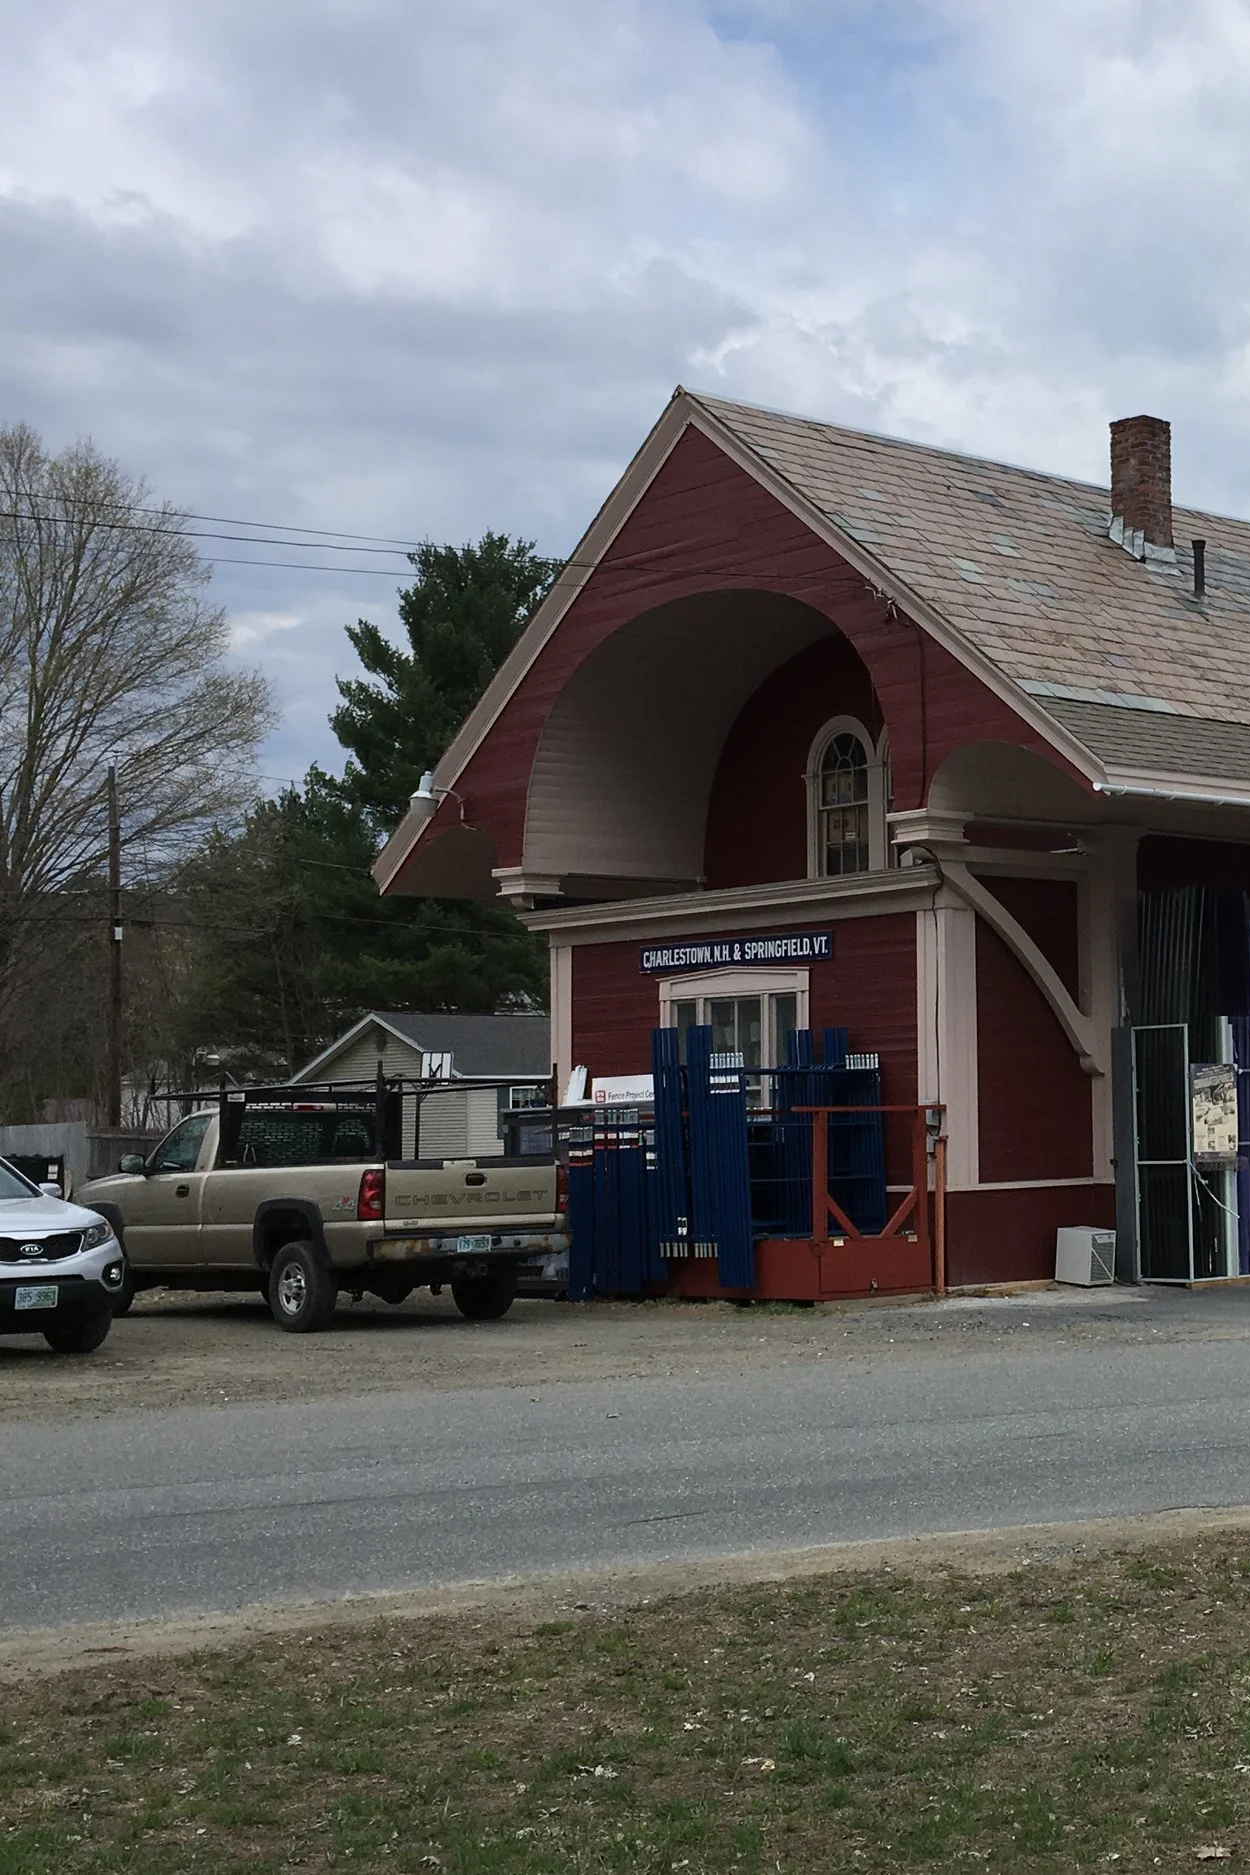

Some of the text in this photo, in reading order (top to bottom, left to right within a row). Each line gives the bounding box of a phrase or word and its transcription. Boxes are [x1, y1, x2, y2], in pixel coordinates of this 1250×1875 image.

[643, 936, 828, 968] CHARLESTOWN, N.H. & SPRINGFIELD, VT.
[395, 1190, 548, 1207] CHEVROLET
